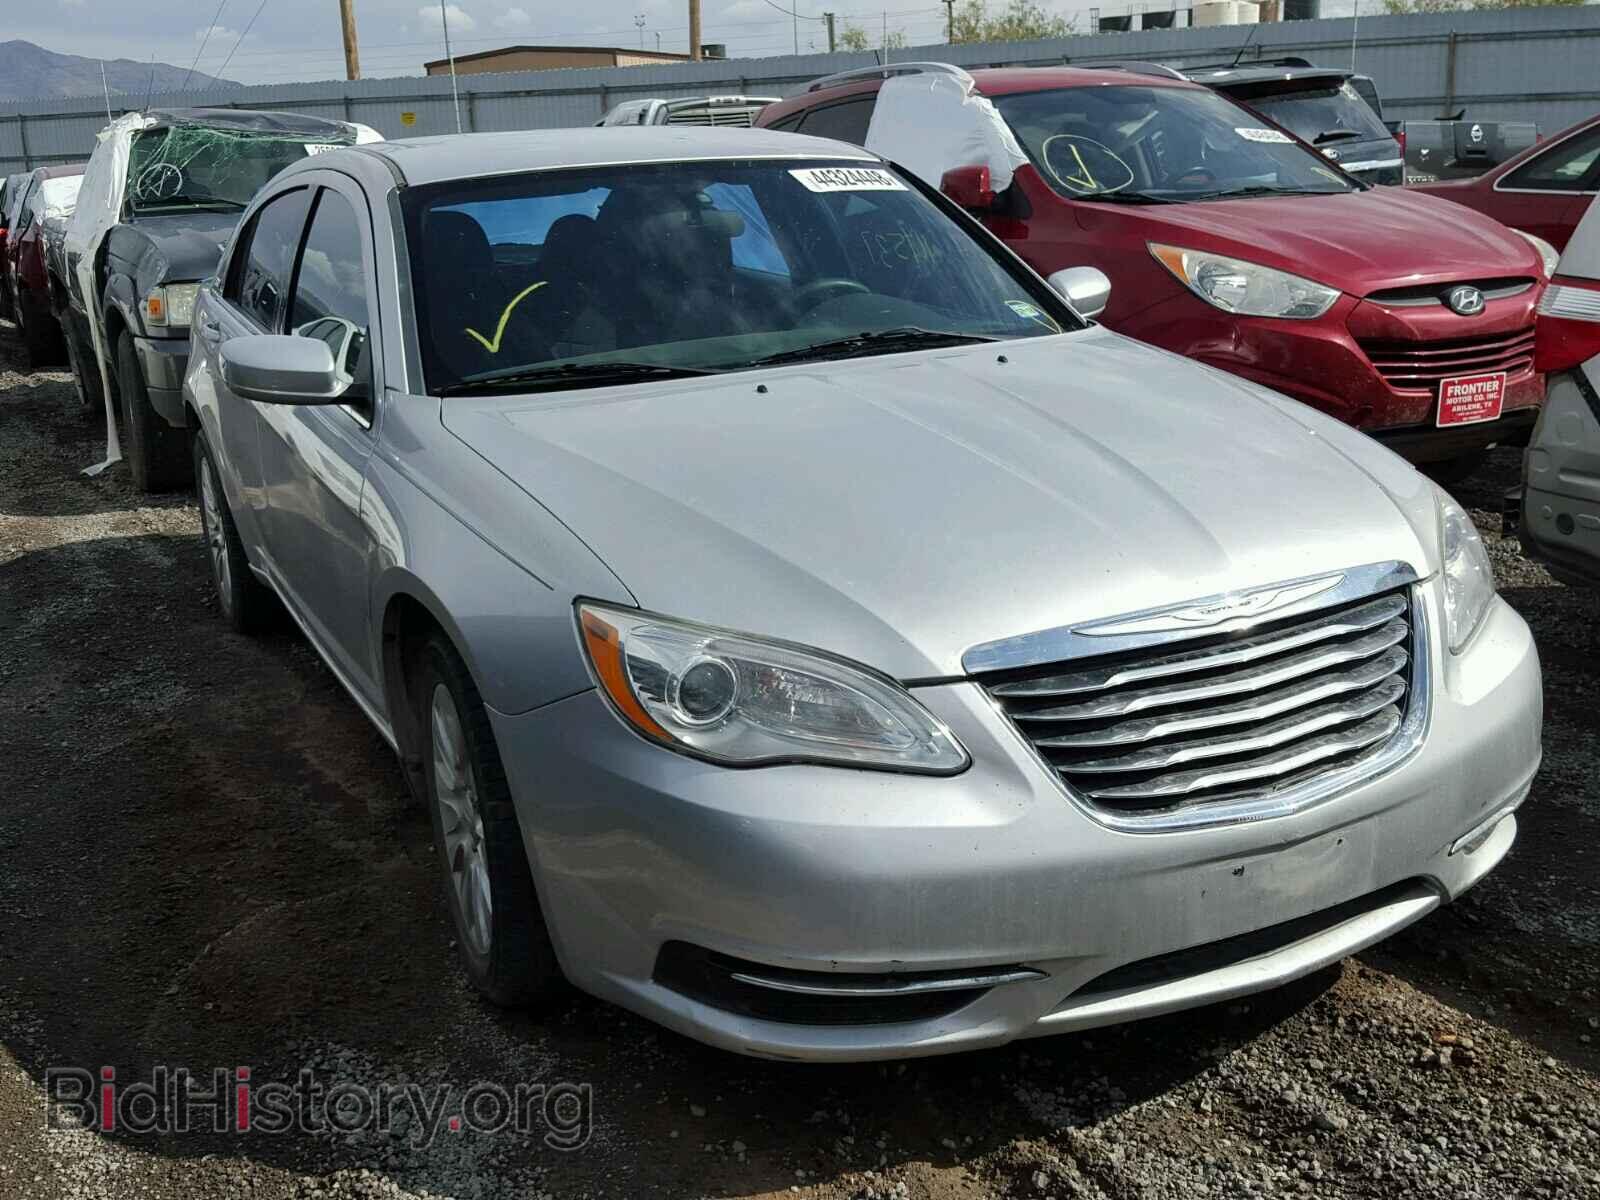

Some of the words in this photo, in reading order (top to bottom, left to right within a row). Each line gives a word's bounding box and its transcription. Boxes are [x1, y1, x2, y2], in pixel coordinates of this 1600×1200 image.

[809, 169, 892, 187] 44324448
[1447, 381, 1500, 397] FRONTIER
[1446, 396, 1473, 406] MOTOR
